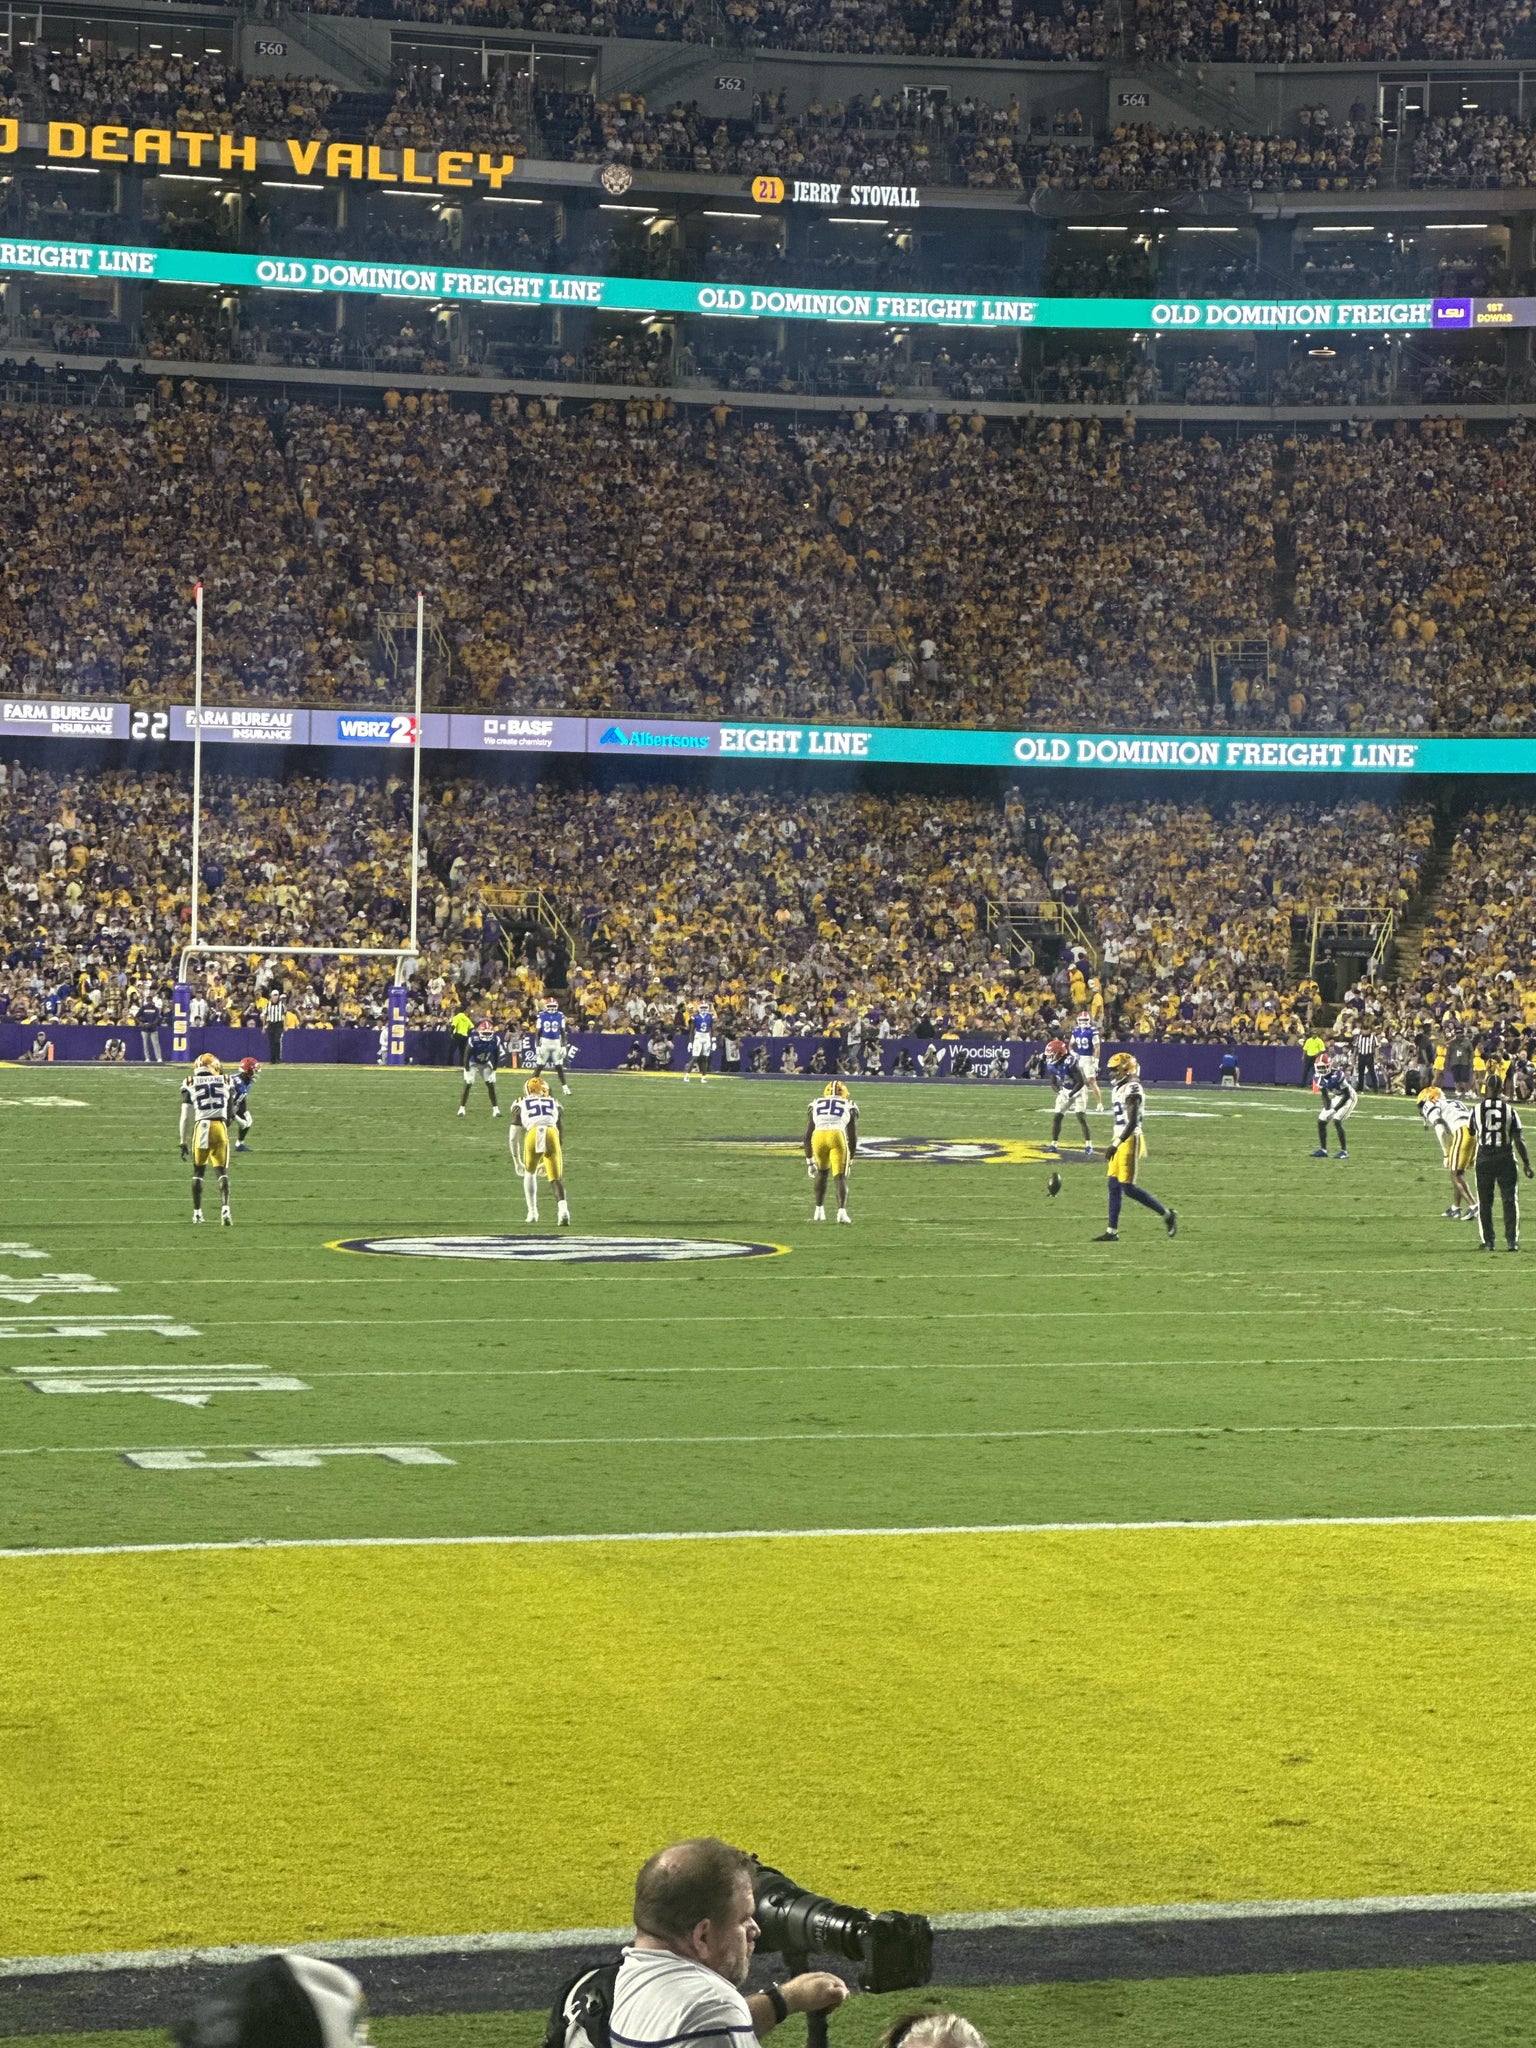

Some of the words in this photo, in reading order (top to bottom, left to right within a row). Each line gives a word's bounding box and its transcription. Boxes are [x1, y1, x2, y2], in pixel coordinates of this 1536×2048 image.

[260, 43, 283, 55] 560
[719, 78, 741, 90] 562
[1123, 94, 1145, 107] 564
[48, 121, 256, 171] DEATH
[287, 139, 514, 189] VALLEY
[759, 180, 777, 198] 21
[792, 181, 841, 204] JERRY
[850, 185, 920, 207] STOVALL
[98, 250, 155, 273] LINE
[256, 260, 307, 283] OLD
[312, 264, 437, 292] DOMINION
[442, 272, 544, 298] FREIGHT
[549, 279, 602, 301] LINE
[697, 287, 745, 310] OLD
[750, 291, 871, 316] DOMINION
[876, 297, 977, 319] FREIGHT
[982, 300, 1034, 321] LINE
[1437, 308, 1465, 318] LSU
[1151, 303, 1200, 324] OLD
[1206, 304, 1331, 325] DOMINION
[1477, 313, 1513, 323] DOWNS
[3, 704, 48, 719] FARM
[50, 705, 114, 722] BUREAU
[185, 709, 229, 725] FARM
[231, 711, 294, 728] BUREAU
[51, 722, 113, 735] INSURANCE
[131, 711, 168, 740] 22
[232, 728, 292, 741] INSURANCE
[340, 720, 390, 738] WBRZ
[508, 720, 553, 736] BASF
[496, 738, 518, 746] create
[519, 737, 552, 748] chemistry
[628, 731, 708, 749] Albertsons
[720, 728, 801, 753] EIGHT
[808, 731, 868, 755] LINE
[1014, 738, 1070, 762] OLD
[1077, 740, 1219, 764] DOMINION
[1226, 743, 1345, 766] FREIGHT
[1352, 744, 1414, 767] LINE
[173, 1003, 188, 1051] LSU
[391, 1007, 405, 1055] LSU
[949, 1044, 1011, 1059] Woodside
[195, 1083, 225, 1110] 25
[525, 1098, 554, 1118] 52
[816, 1099, 846, 1118] 26
[1485, 1109, 1502, 1131] C
